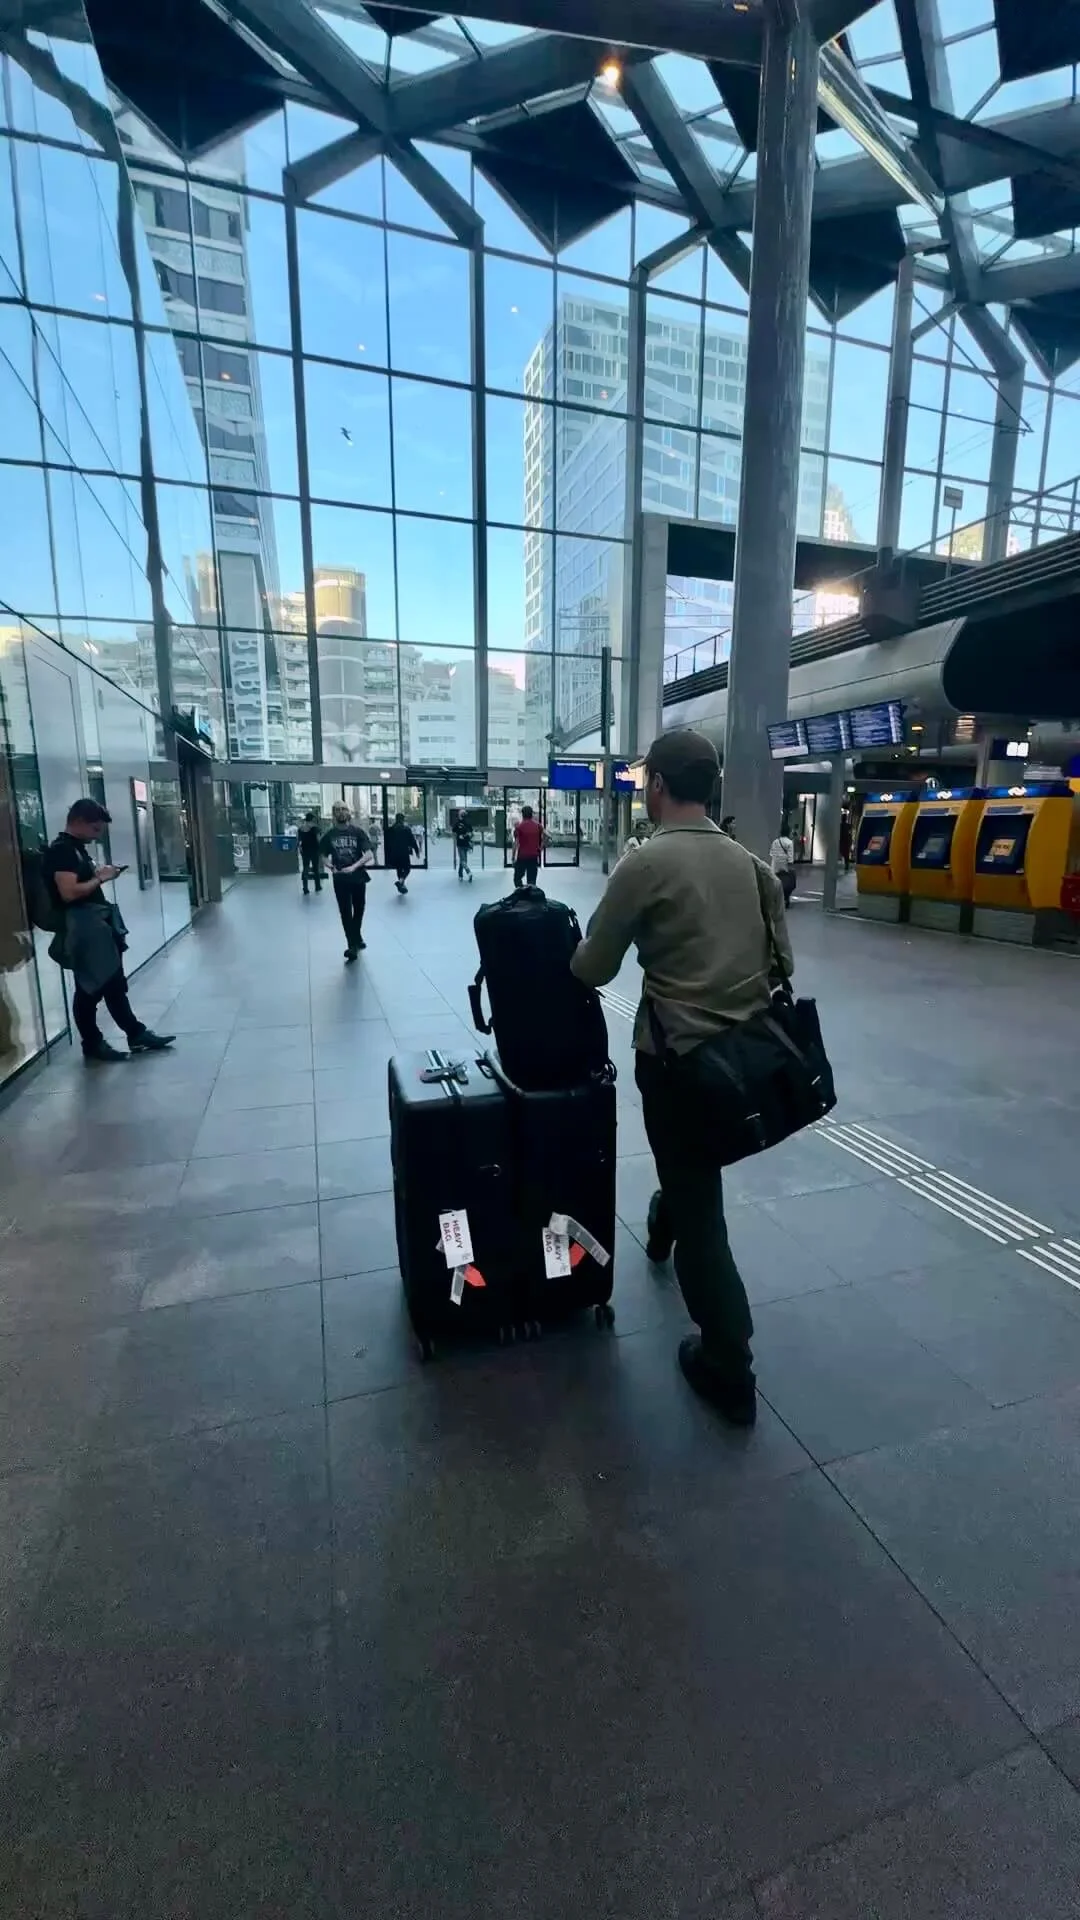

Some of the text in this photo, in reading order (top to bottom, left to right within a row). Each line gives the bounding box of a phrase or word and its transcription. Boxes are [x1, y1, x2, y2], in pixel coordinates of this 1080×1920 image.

[443, 1222, 452, 1241] BAG
[452, 1219, 464, 1248] HEAVY
[545, 1234, 553, 1253] BAG
